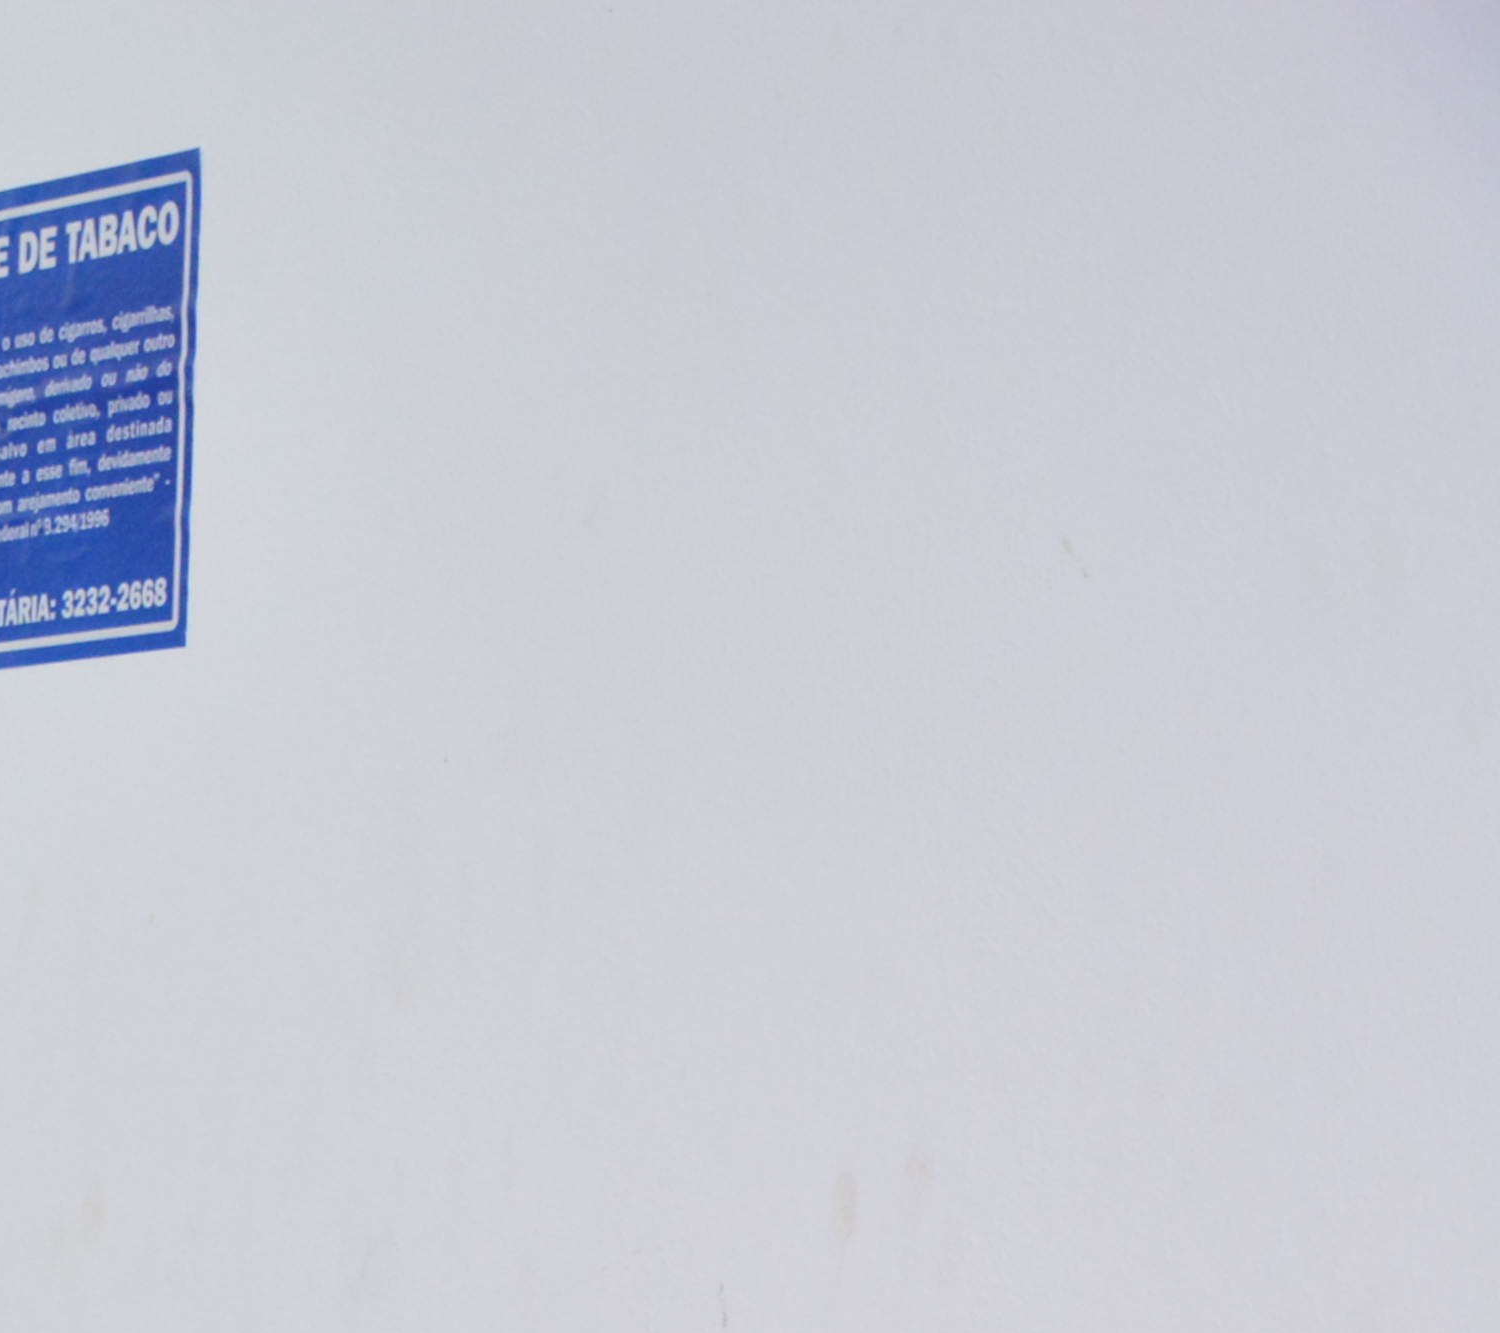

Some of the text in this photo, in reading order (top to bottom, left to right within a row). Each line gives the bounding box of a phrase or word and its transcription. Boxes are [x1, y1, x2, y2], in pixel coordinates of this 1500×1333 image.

[18, 225, 58, 276] DE
[65, 200, 180, 264] TABACO
[2, 337, 10, 351] o
[14, 332, 35, 349] uso
[39, 327, 54, 344] de
[58, 319, 107, 342] cigarros,
[112, 305, 174, 333] cigarrilhas,
[53, 354, 68, 369] ou
[71, 349, 86, 366] de
[90, 340, 140, 365] qualquer
[144, 333, 175, 352] outro
[44, 374, 93, 397] derivado
[101, 372, 117, 387] ou
[126, 364, 148, 383] não
[156, 360, 172, 377] do
[7, 411, 46, 432] recinto
[53, 403, 101, 424] coletivo,
[108, 392, 149, 418] privado
[158, 391, 173, 406] ou
[37, 438, 57, 454] em
[67, 430, 96, 449] área
[106, 416, 172, 443] destinada
[22, 469, 30, 484] a
[36, 464, 63, 482] esse
[69, 457, 90, 476] fim,
[98, 446, 171, 472] devidamente
[17, 488, 80, 513] arejamento
[43, 508, 109, 535] 9.294/1996
[61, 578, 167, 619] 3232-2668
